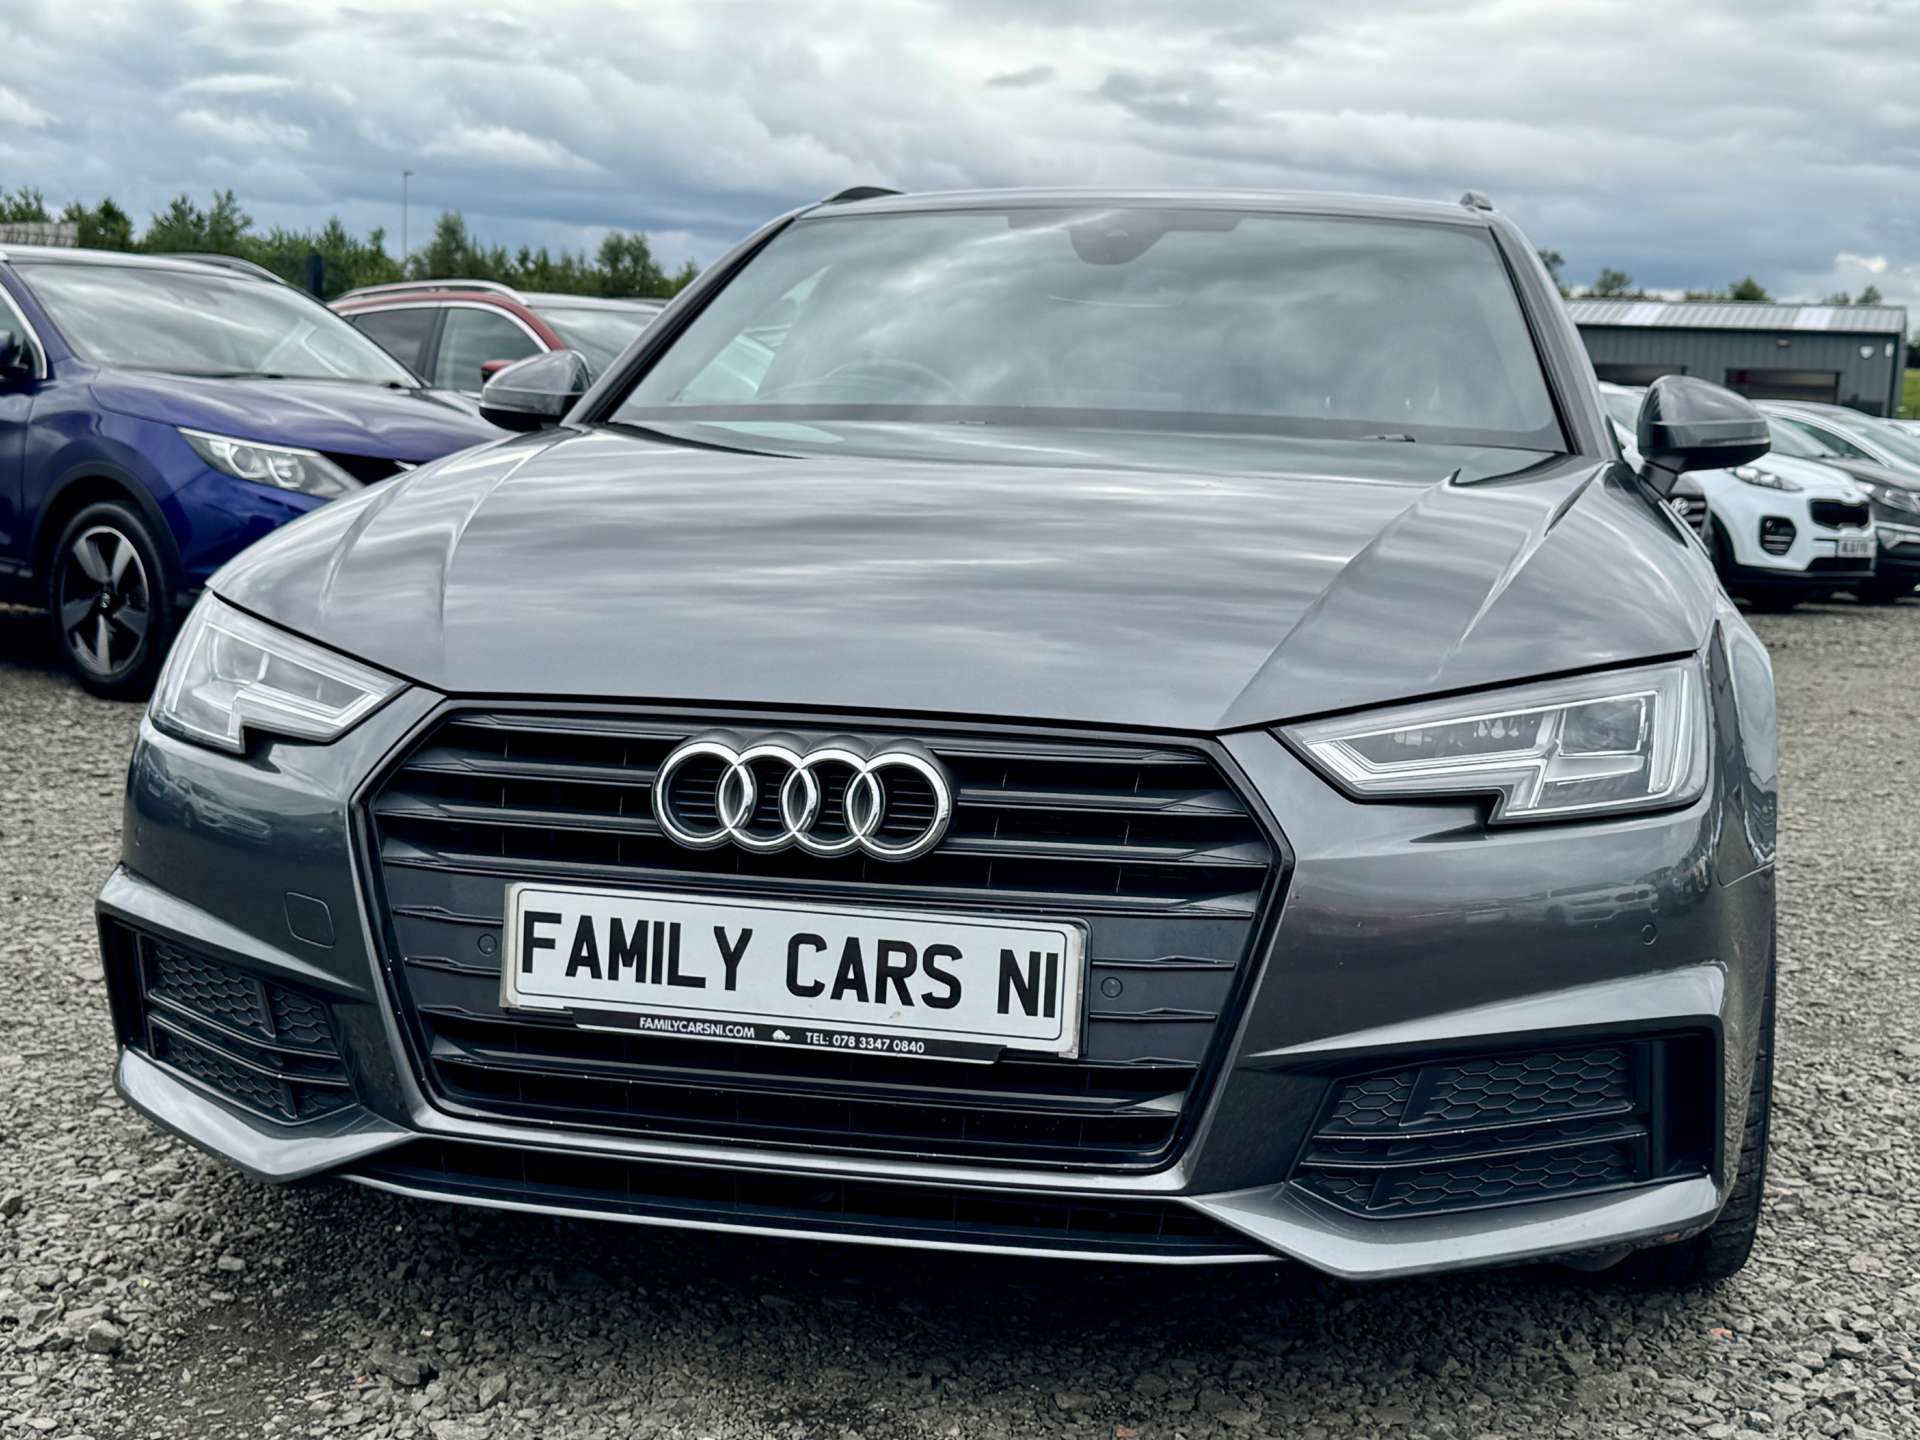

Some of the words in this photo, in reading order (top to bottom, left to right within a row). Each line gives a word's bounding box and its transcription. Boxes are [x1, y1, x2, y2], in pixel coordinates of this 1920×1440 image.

[521, 910, 753, 992] FAMILY
[786, 932, 963, 1010] CARS
[997, 948, 1059, 1019] NI
[639, 1016, 755, 1039] FAMILYCARSNI.COM
[805, 1031, 830, 1046] TEL:
[832, 1034, 856, 1048] 078
[858, 1036, 891, 1051] 3347
[892, 1039, 925, 1054] 0840
